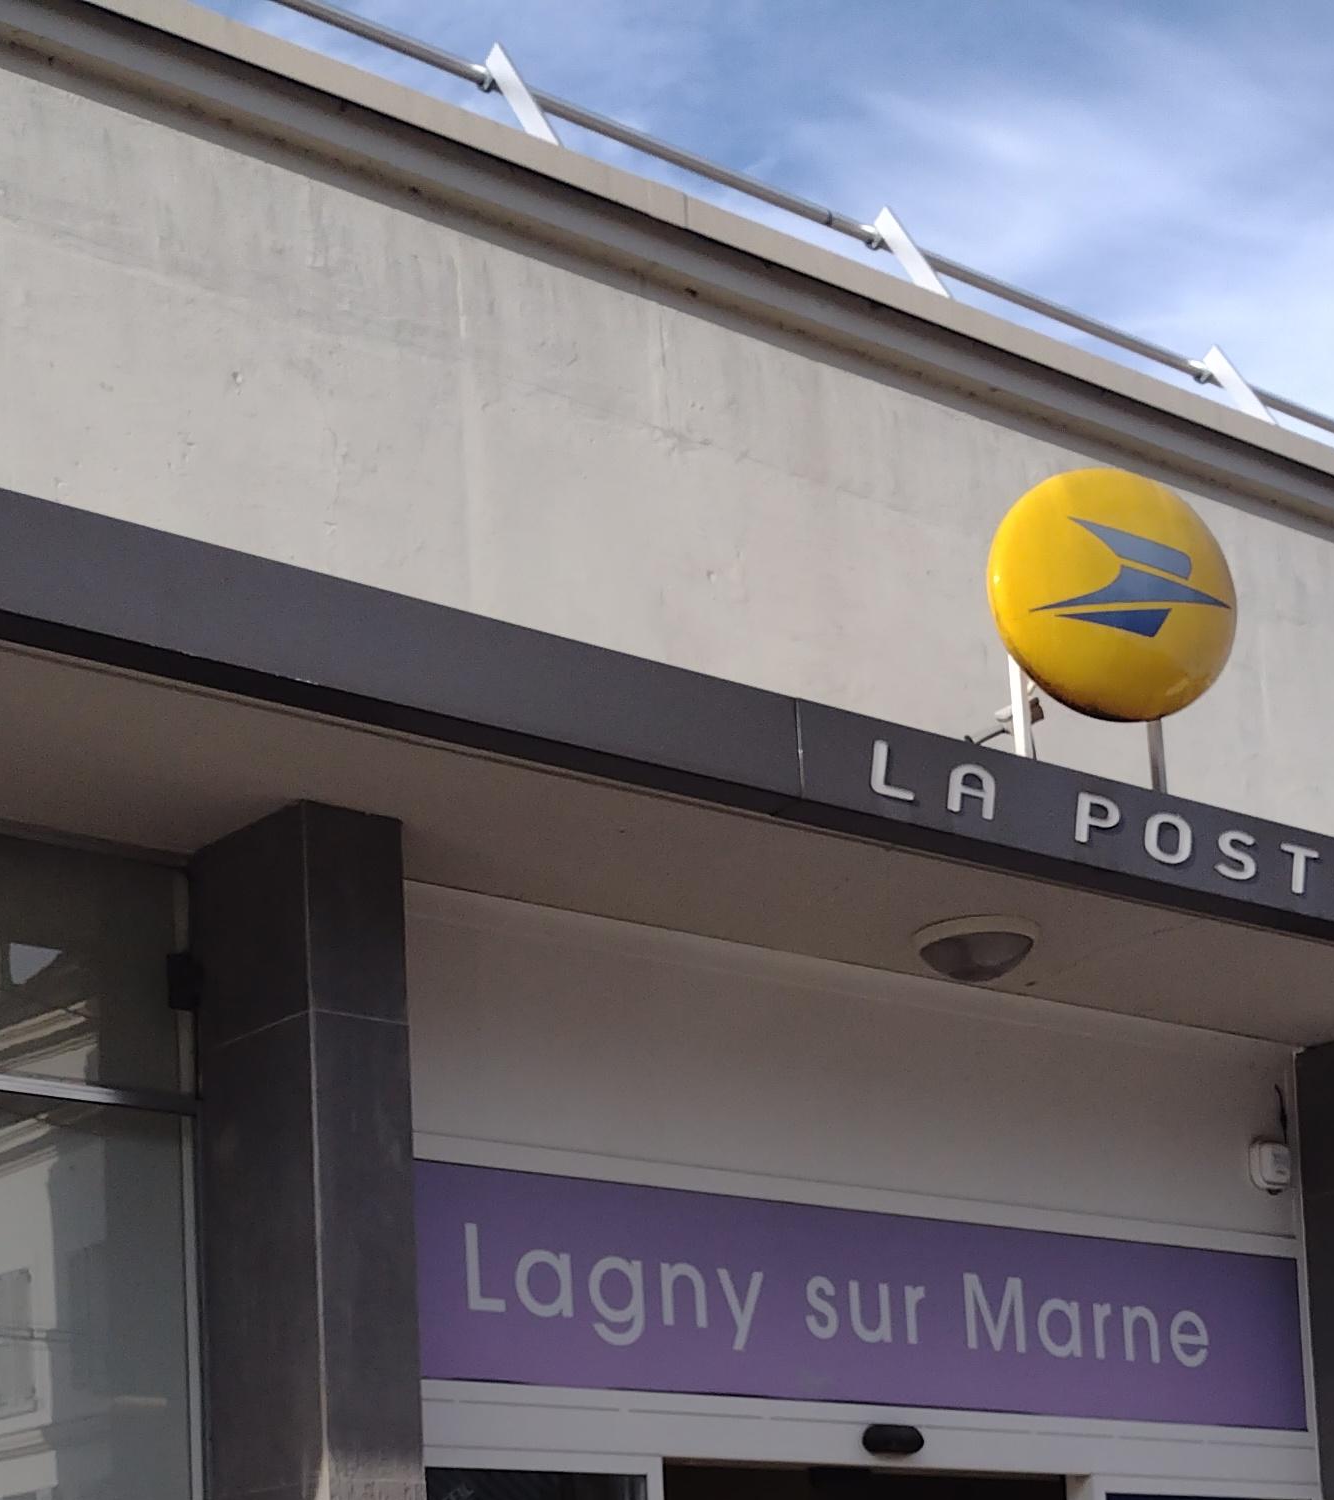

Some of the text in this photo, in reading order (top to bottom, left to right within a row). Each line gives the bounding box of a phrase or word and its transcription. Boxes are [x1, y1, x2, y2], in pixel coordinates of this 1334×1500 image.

[870, 739, 996, 821] LA
[464, 1222, 1211, 1368] Lagny sur Marne
